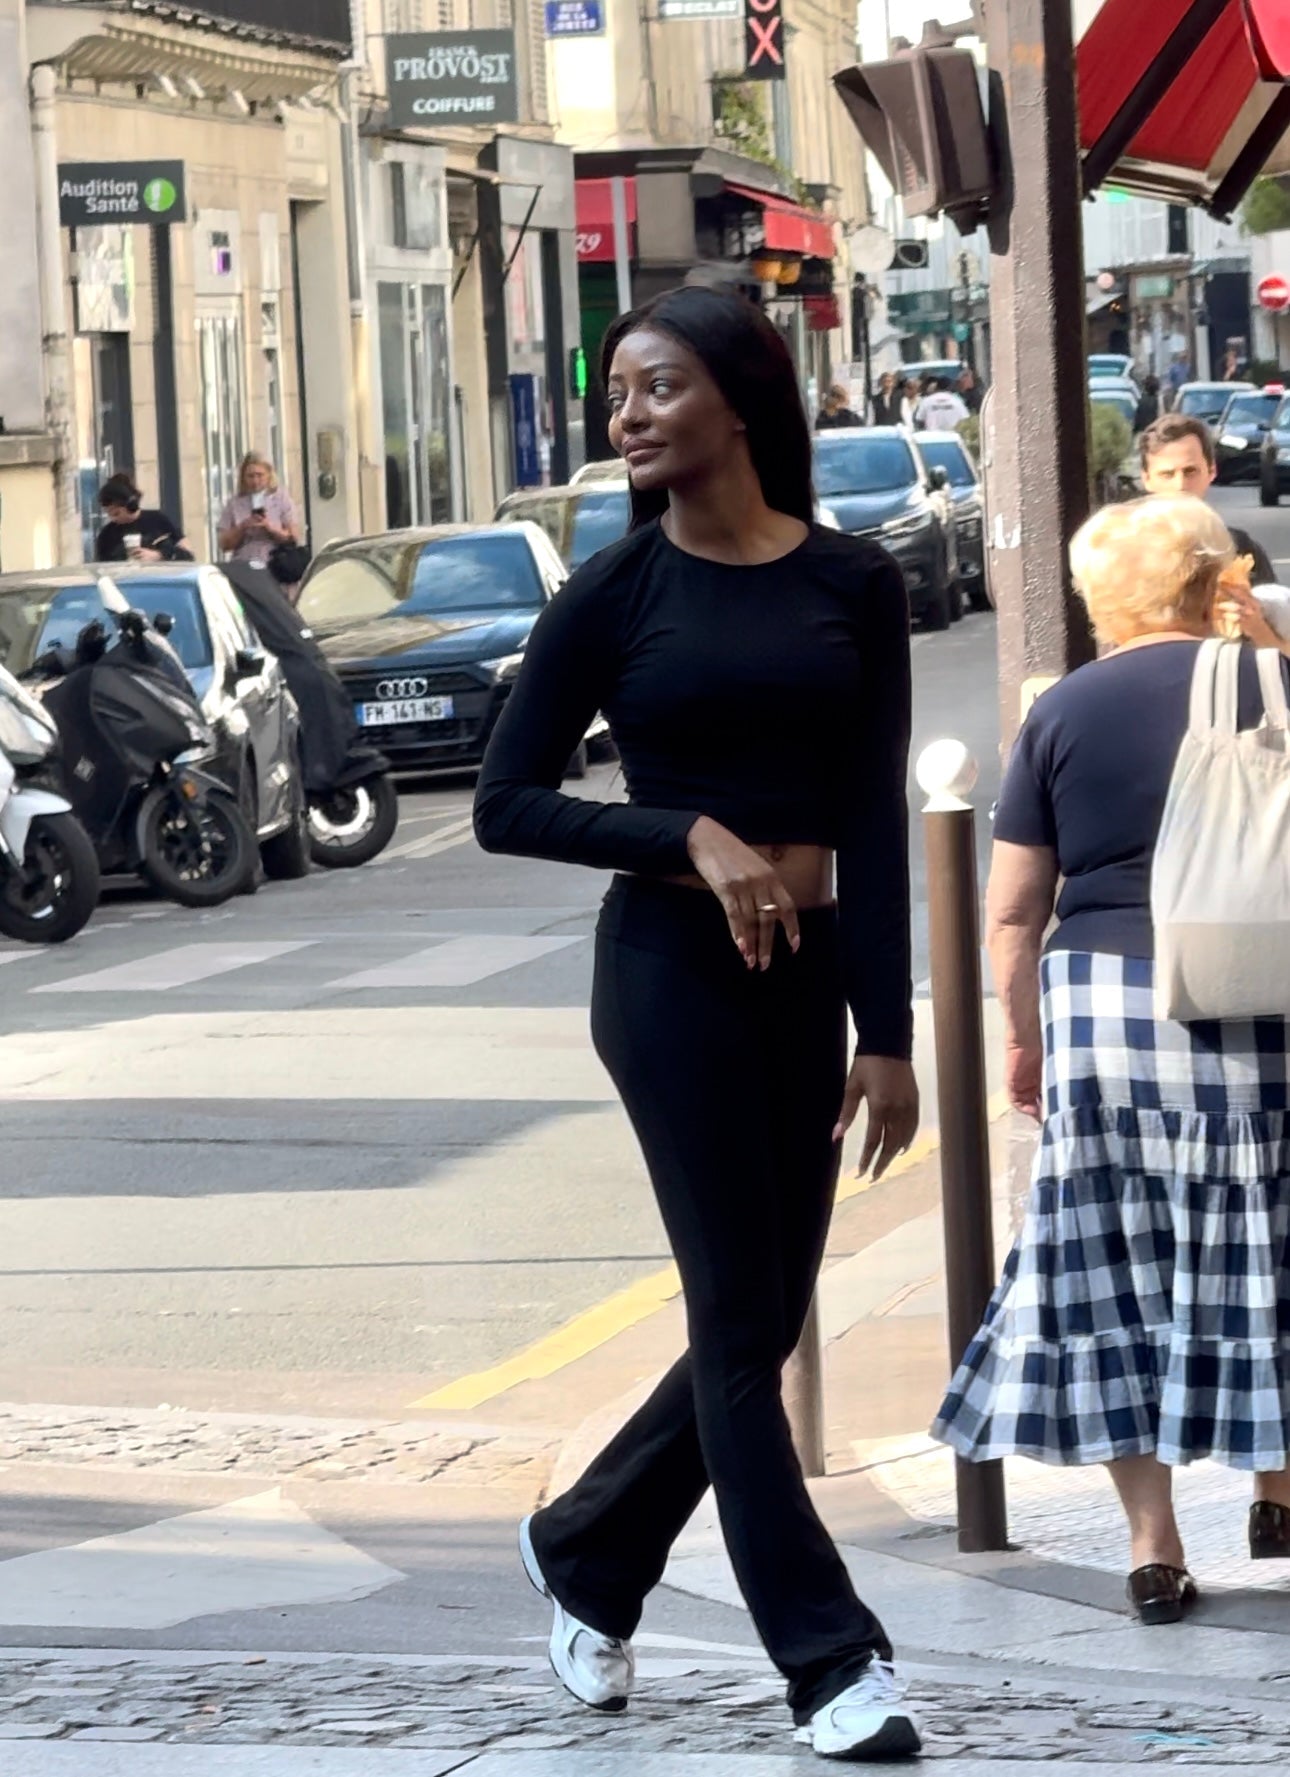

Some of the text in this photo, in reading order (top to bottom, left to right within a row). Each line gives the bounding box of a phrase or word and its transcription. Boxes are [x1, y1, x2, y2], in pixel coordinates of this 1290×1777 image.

[748, 0, 783, 66] X
[393, 54, 510, 81] PROVOST
[412, 96, 495, 114] COIFFURE
[60, 179, 138, 197] Audition
[85, 197, 139, 213] Santé
